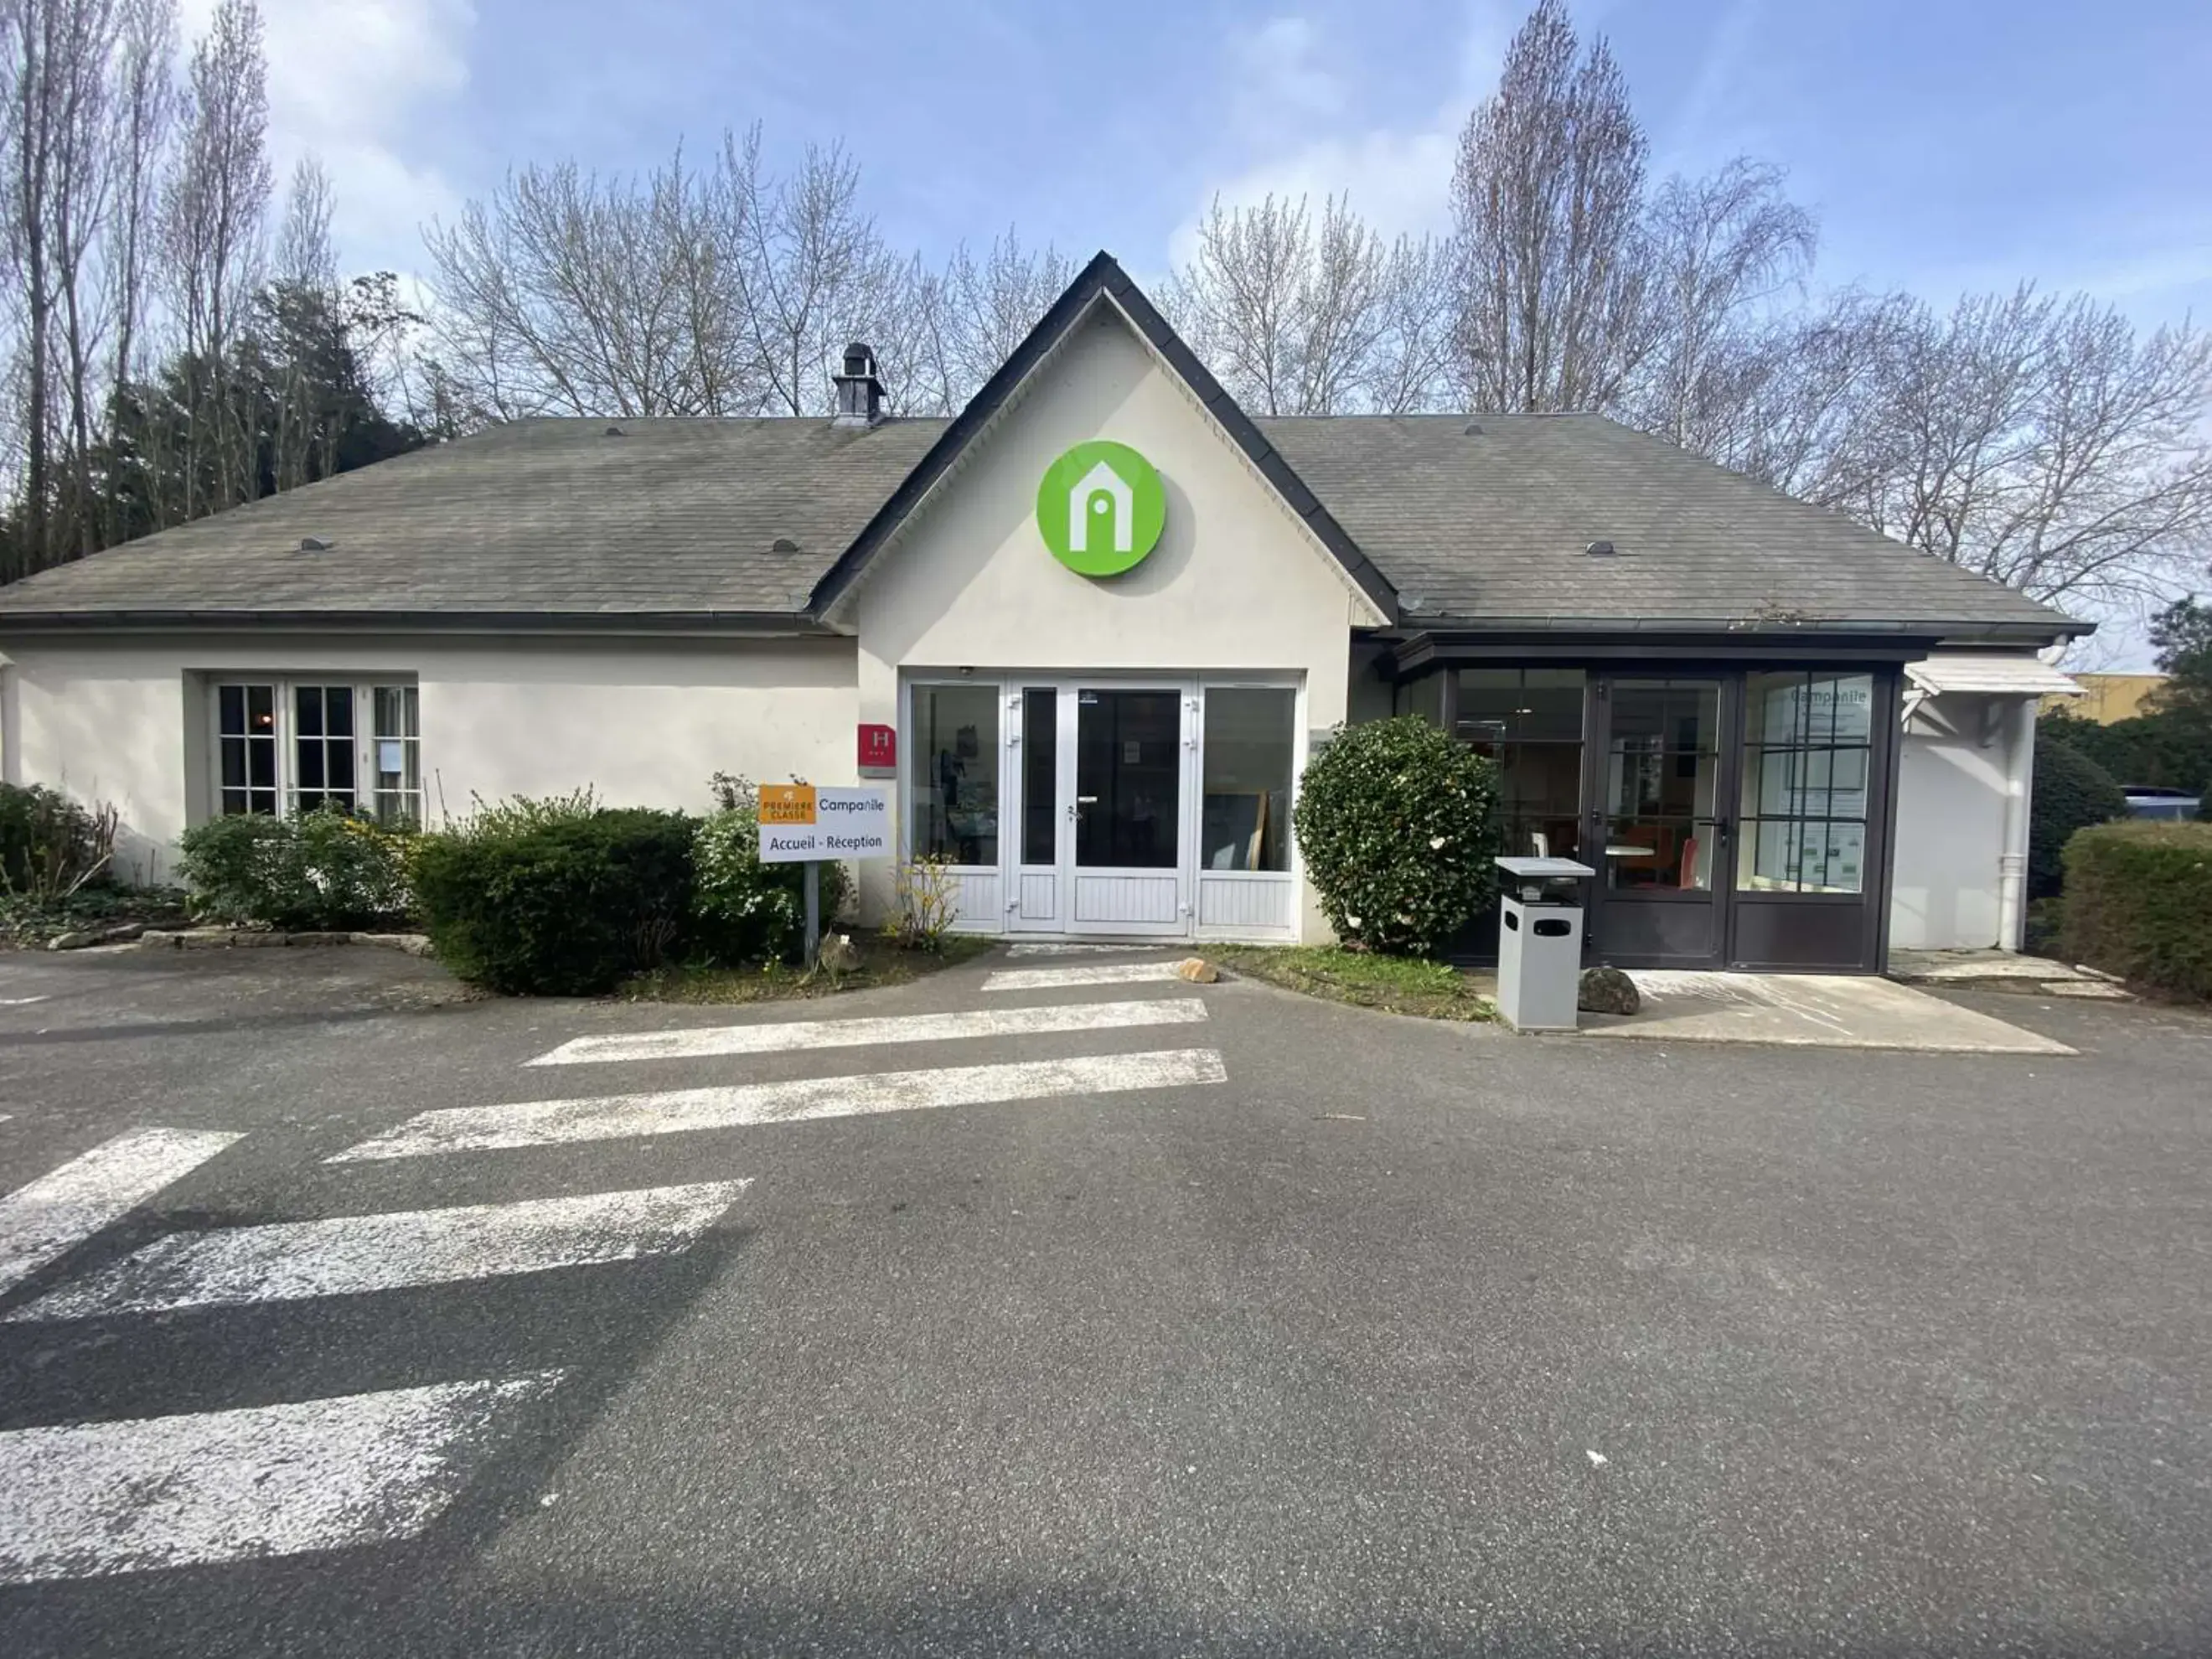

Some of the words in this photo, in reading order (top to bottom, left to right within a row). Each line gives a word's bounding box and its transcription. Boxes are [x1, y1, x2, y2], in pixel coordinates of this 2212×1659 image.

[873, 731, 888, 747] H
[819, 798, 884, 814] Campanile
[770, 811, 805, 819] CLASSE
[769, 835, 814, 850] Accueil
[827, 835, 882, 850] Réception
